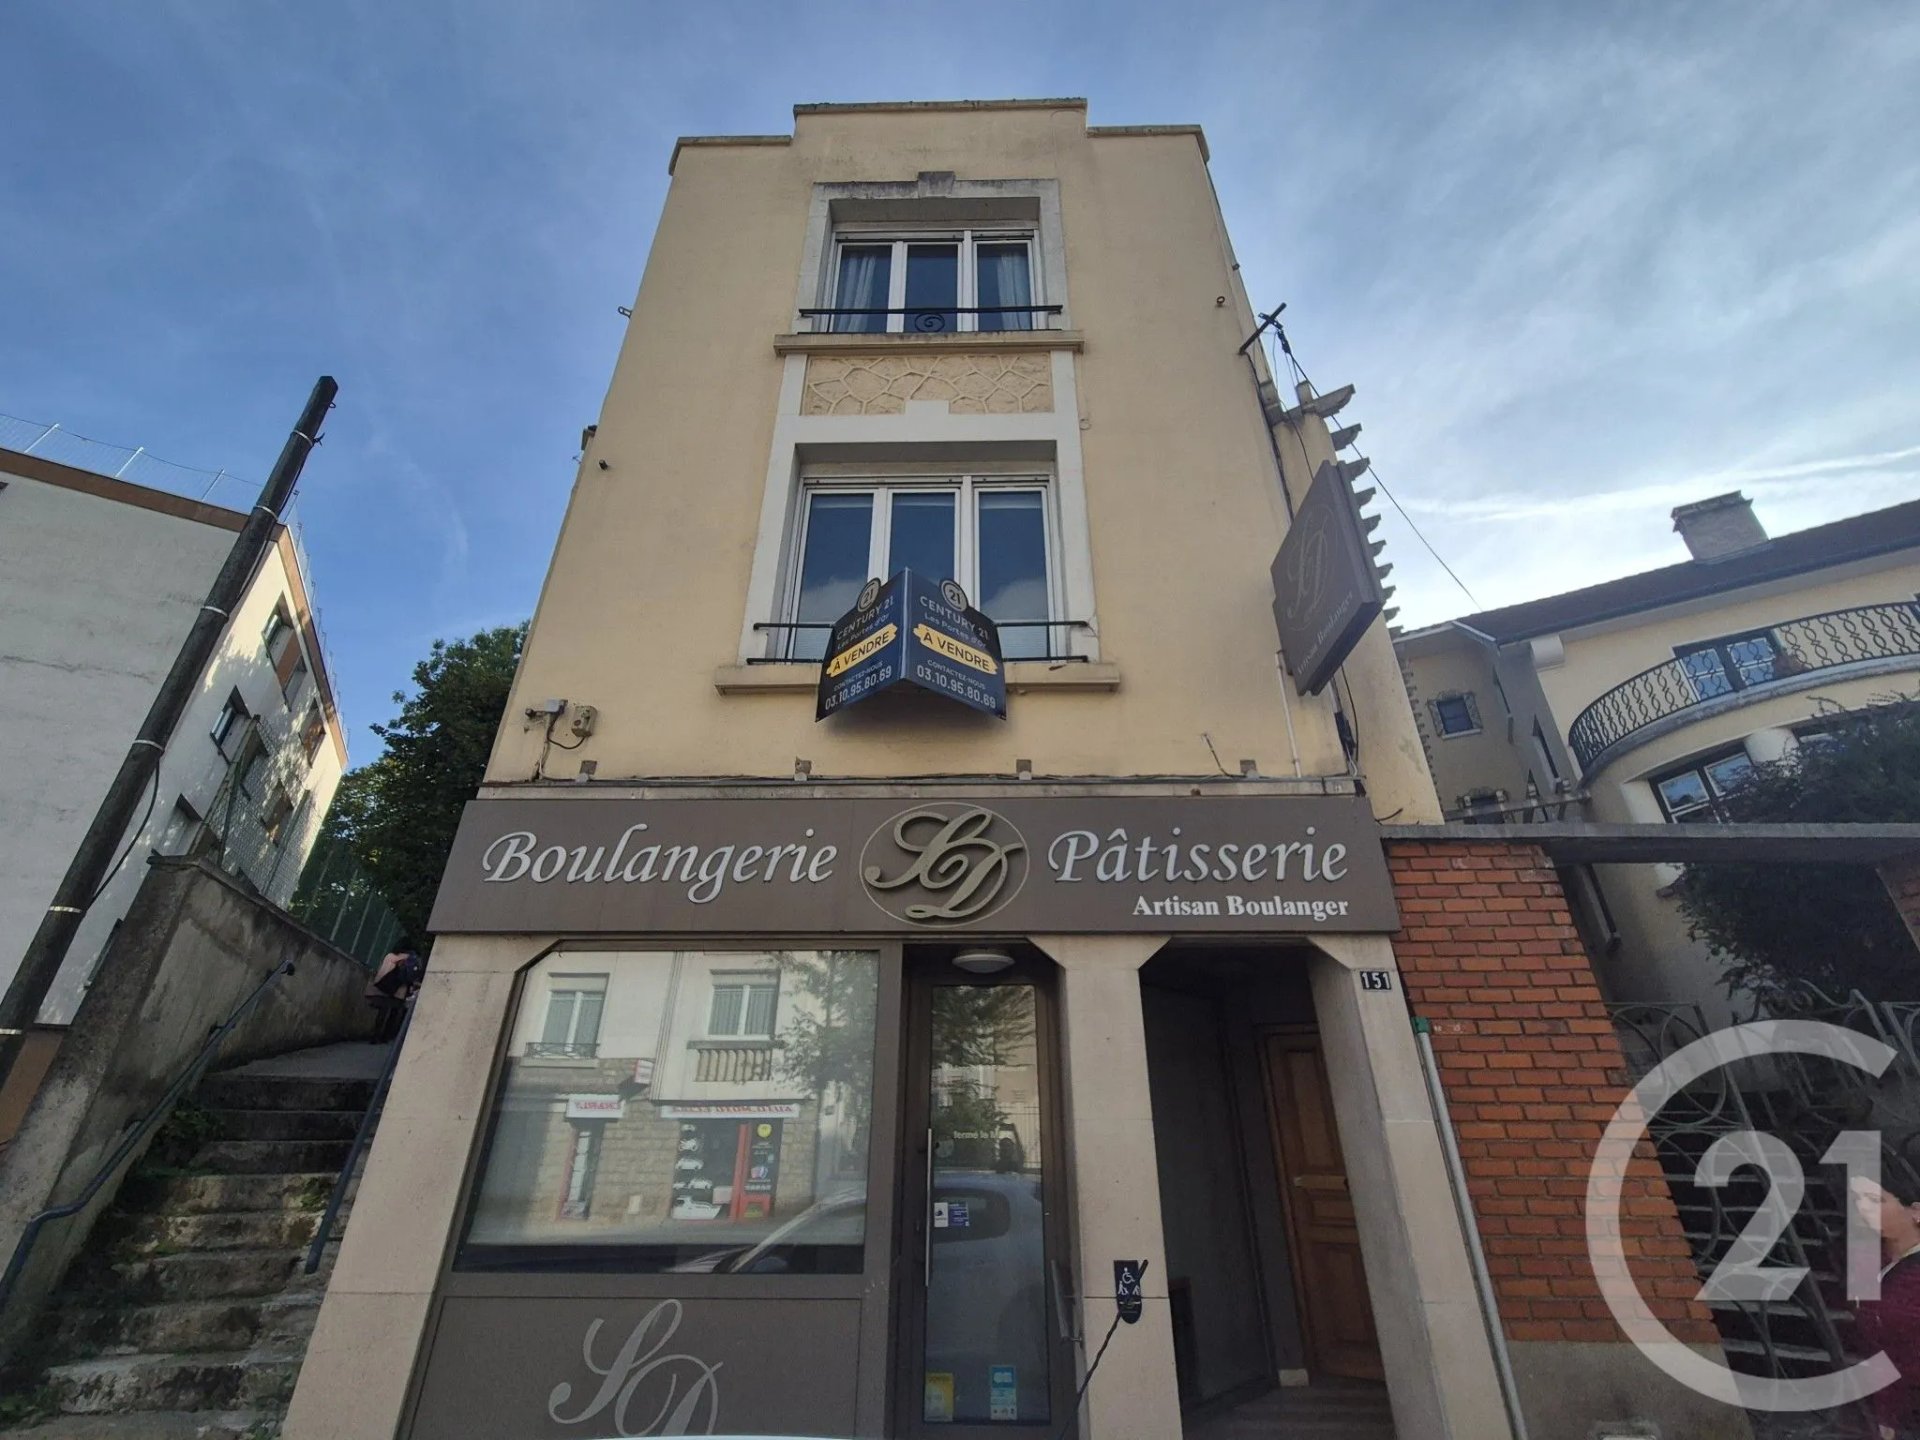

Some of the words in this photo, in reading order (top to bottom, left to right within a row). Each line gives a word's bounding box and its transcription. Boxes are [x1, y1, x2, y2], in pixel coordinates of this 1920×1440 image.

[836, 608, 881, 639] CENTURY
[884, 596, 894, 609] 21
[920, 596, 975, 631] CENTURY
[979, 627, 989, 640] 21
[949, 590, 960, 605] 21
[833, 657, 841, 672] À
[845, 630, 890, 665] VENDRE
[923, 628, 934, 644] À
[938, 636, 990, 671] VENDRE
[825, 665, 891, 710] 03.10.95.80.69
[917, 665, 996, 709] 03.10.95.80.69
[482, 823, 837, 904] Boulangerie
[1047, 826, 1348, 884] Pâtisserie
[1132, 897, 1219, 917] Artisan
[1227, 895, 1348, 921] Boulanger
[1362, 973, 1391, 989] 151
